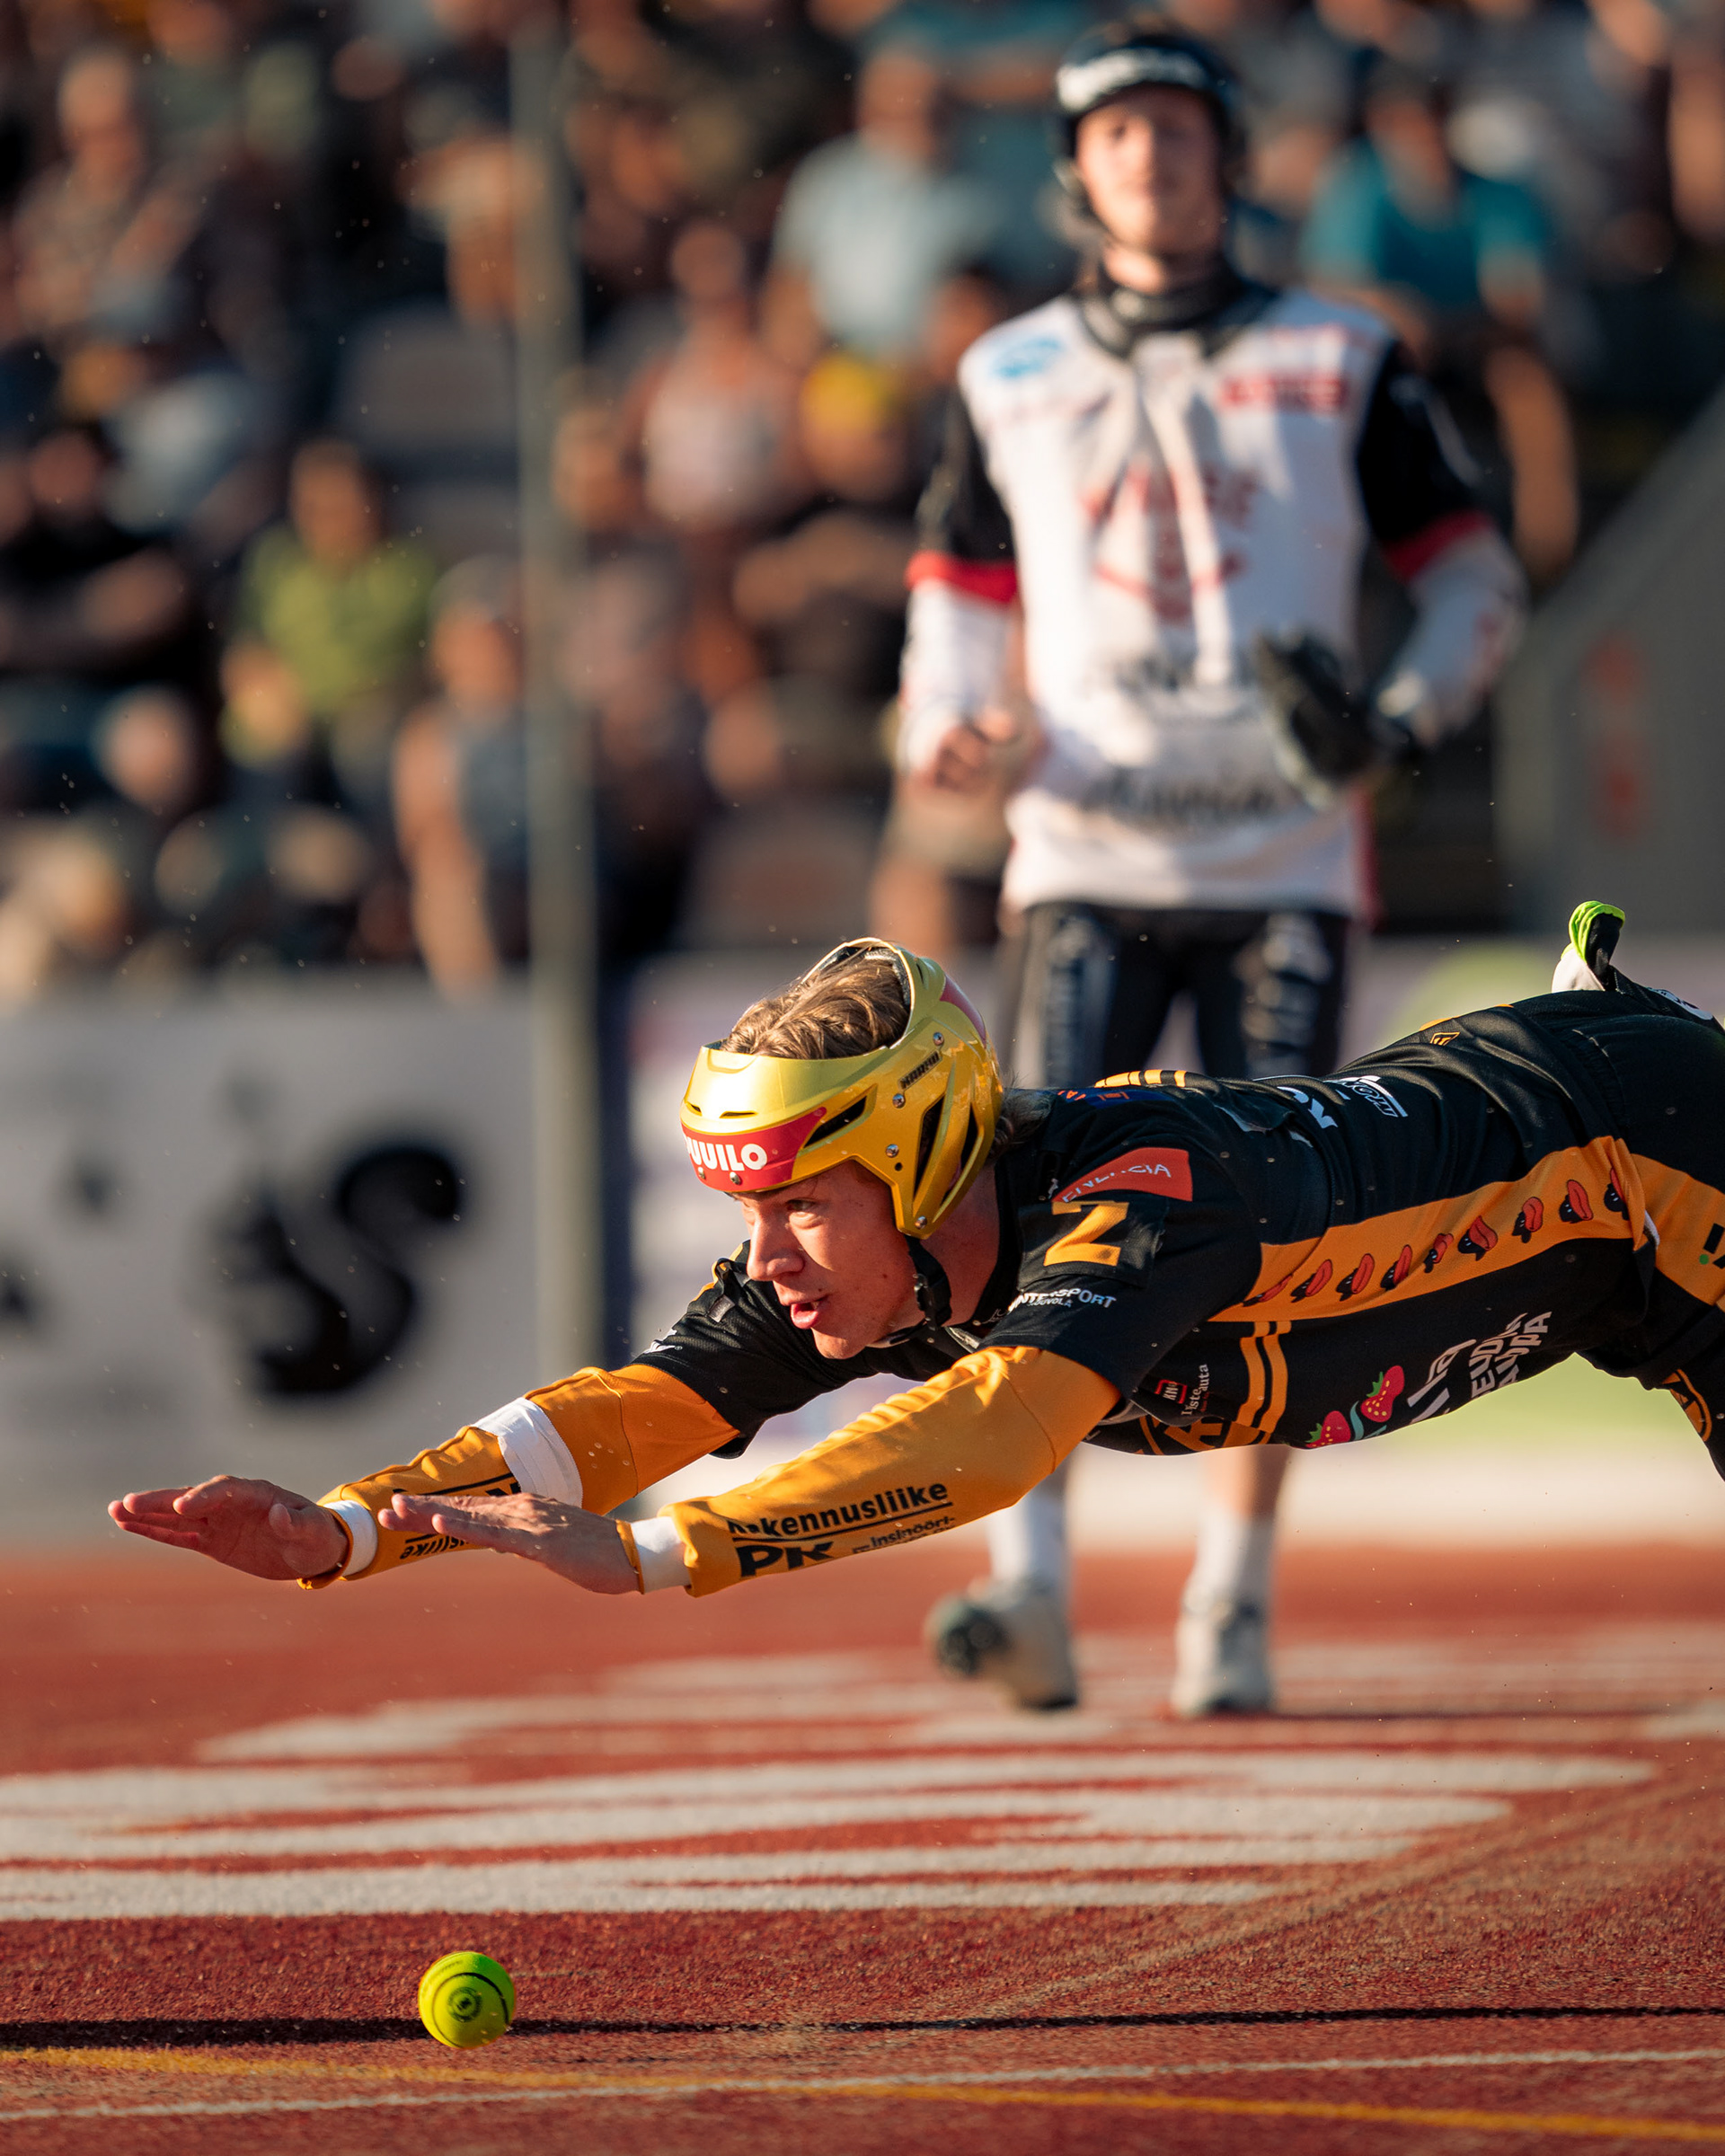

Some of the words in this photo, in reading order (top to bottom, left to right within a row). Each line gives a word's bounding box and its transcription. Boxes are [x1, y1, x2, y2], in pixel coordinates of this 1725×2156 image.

[683, 1134, 768, 1171] UUILO
[1007, 1287, 1117, 1312] INTESPORT
[735, 1541, 834, 1577] PK
